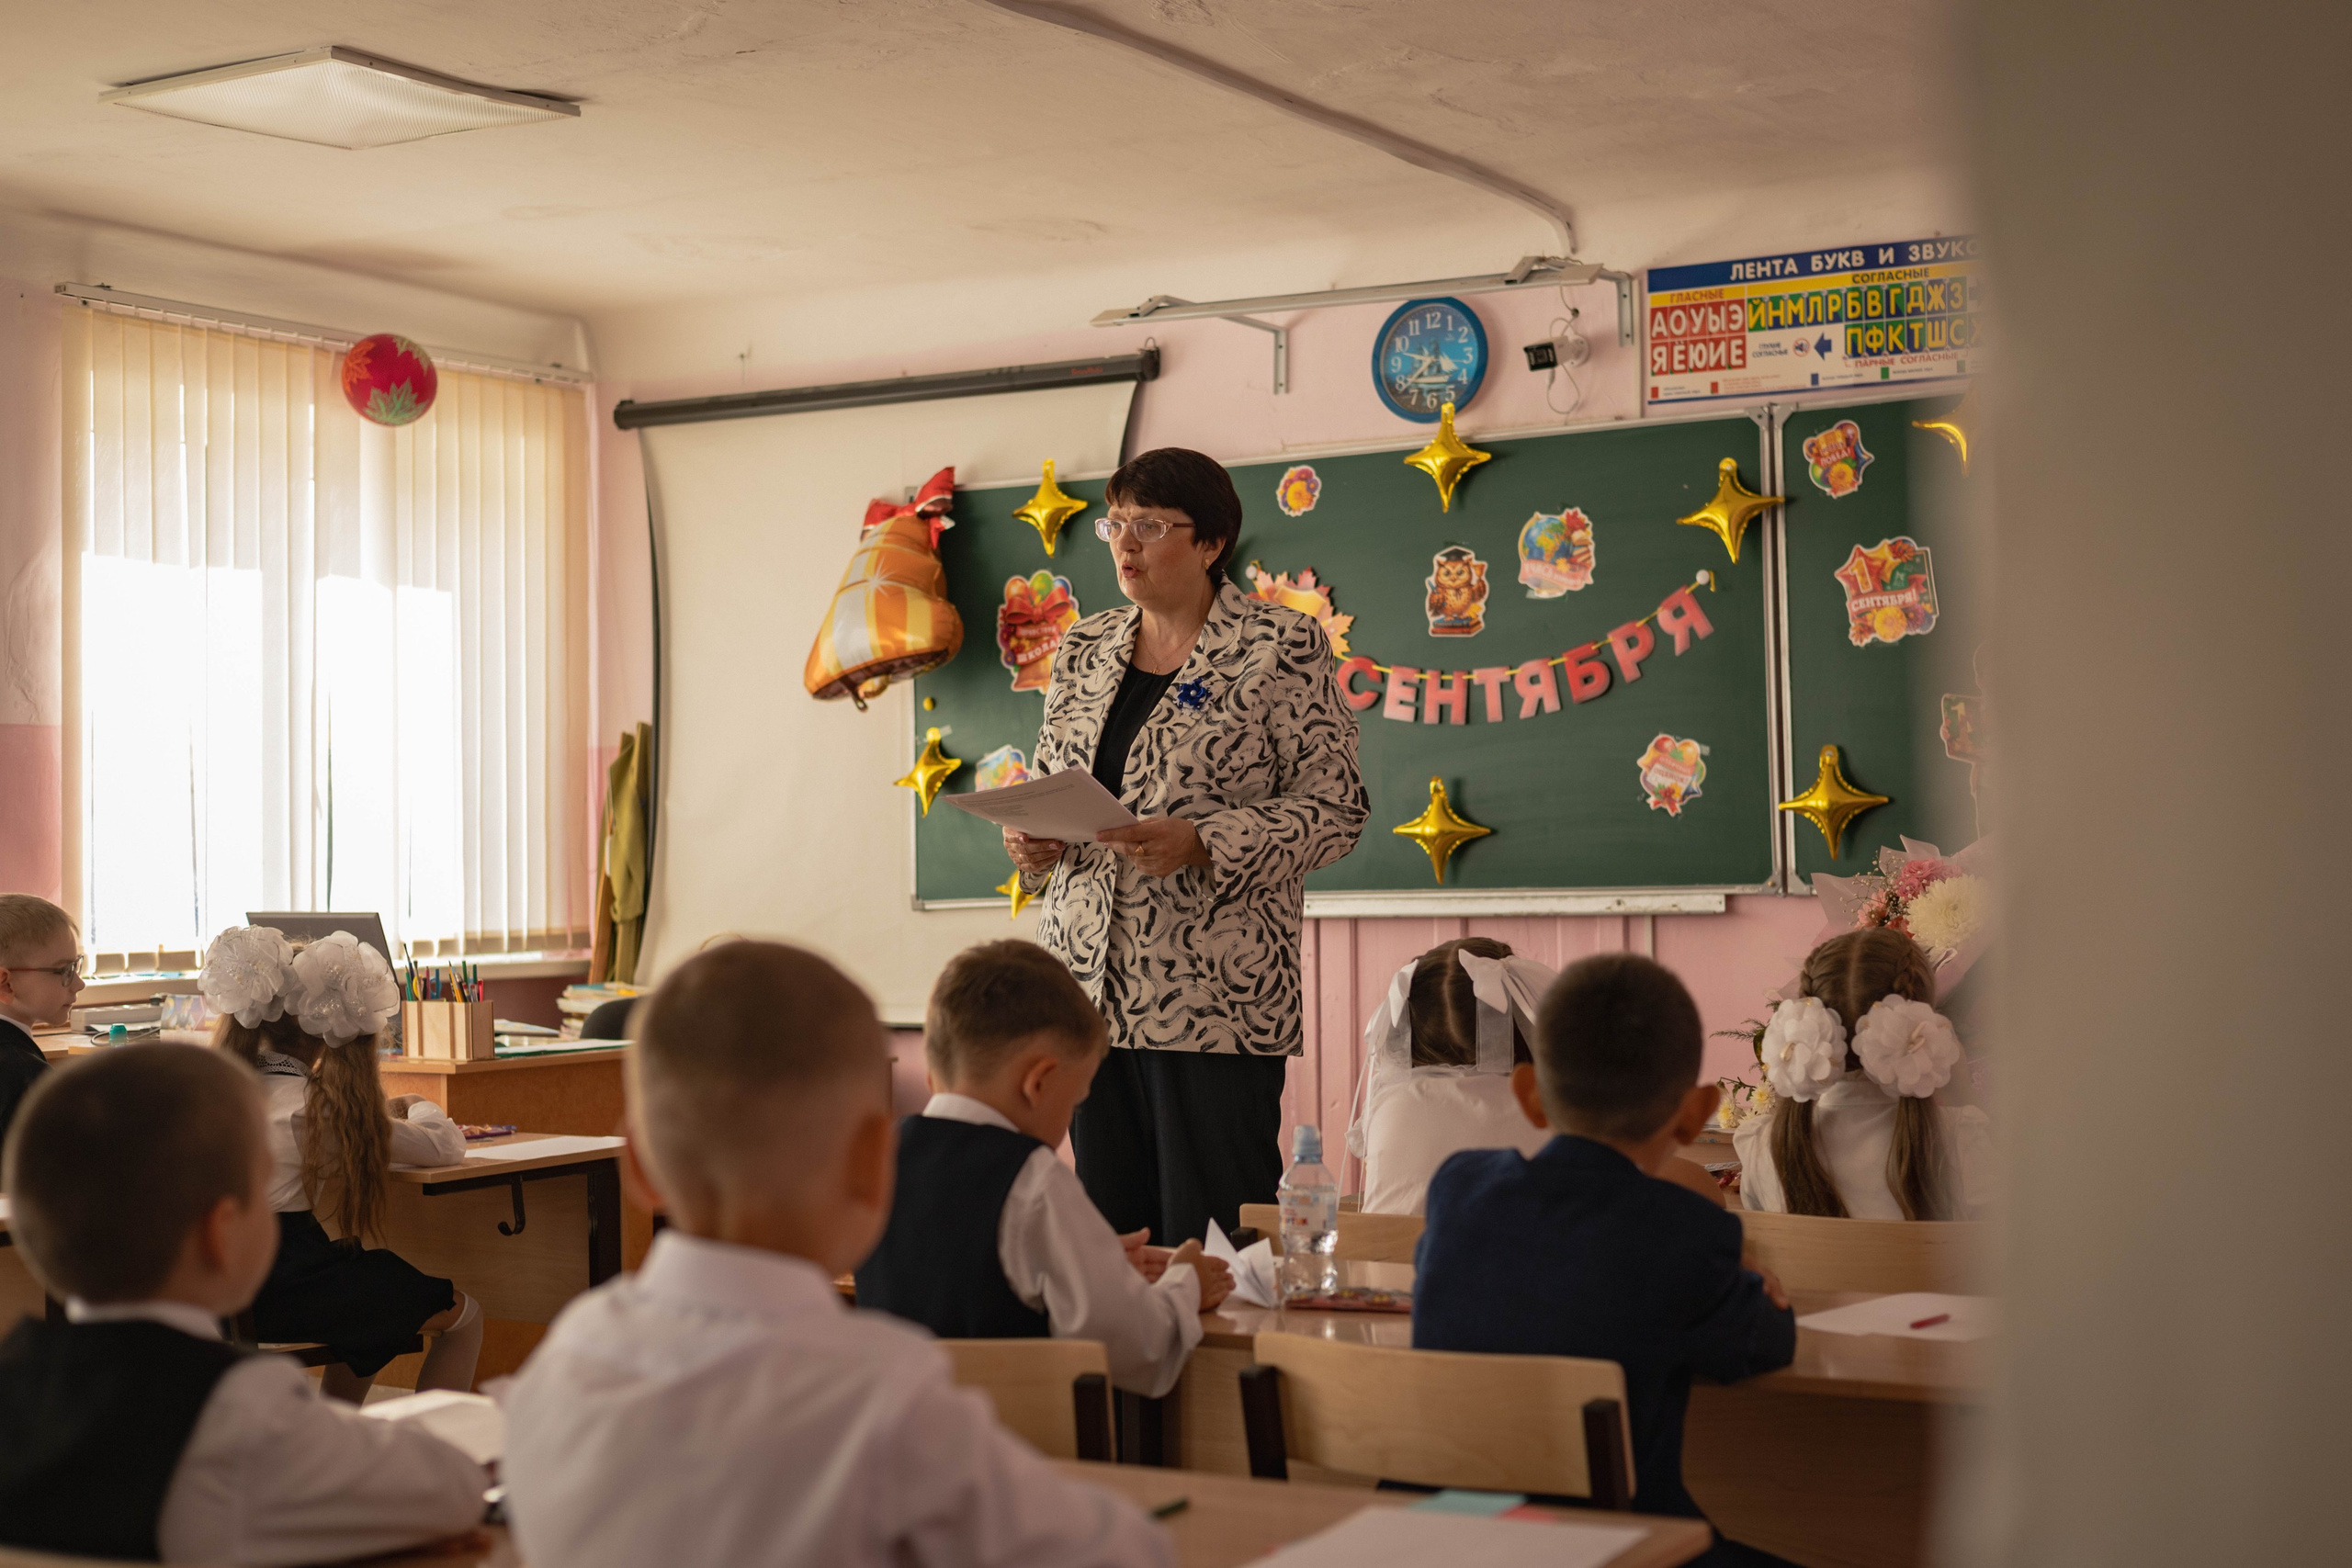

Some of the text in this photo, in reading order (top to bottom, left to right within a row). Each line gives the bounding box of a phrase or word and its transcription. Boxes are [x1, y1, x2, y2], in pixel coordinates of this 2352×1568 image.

[1730, 257, 1799, 281] ЛЕНТА
[1811, 249, 1865, 273] БУКВ
[1878, 246, 1895, 265] И
[1852, 266, 1930, 284] СОГЛАСНЫЕ
[1669, 288, 1725, 304] ГЛАСНЫЕ
[1408, 319, 1420, 337] 11
[1426, 311, 1442, 330] 12
[1447, 314, 1453, 332] 1
[1457, 325, 1468, 344] 2
[1395, 334, 1409, 354] 10
[1390, 355, 1402, 373] 9
[1463, 346, 1474, 365] 3
[1854, 356, 1896, 368] ПАРНЫЕ
[1899, 351, 1959, 366] СОГЛАСНЫЕ
[1395, 374, 1408, 392] 8
[1457, 367, 1468, 385] 4
[1408, 389, 1419, 406] 7
[1426, 392, 1438, 410] 6
[1444, 385, 1455, 402] 5
[1848, 557, 1873, 595] 1
[1850, 587, 1918, 613] СЕНТЯБРЯ!
[1336, 584, 1715, 726] СЕНТЯБРЯ
